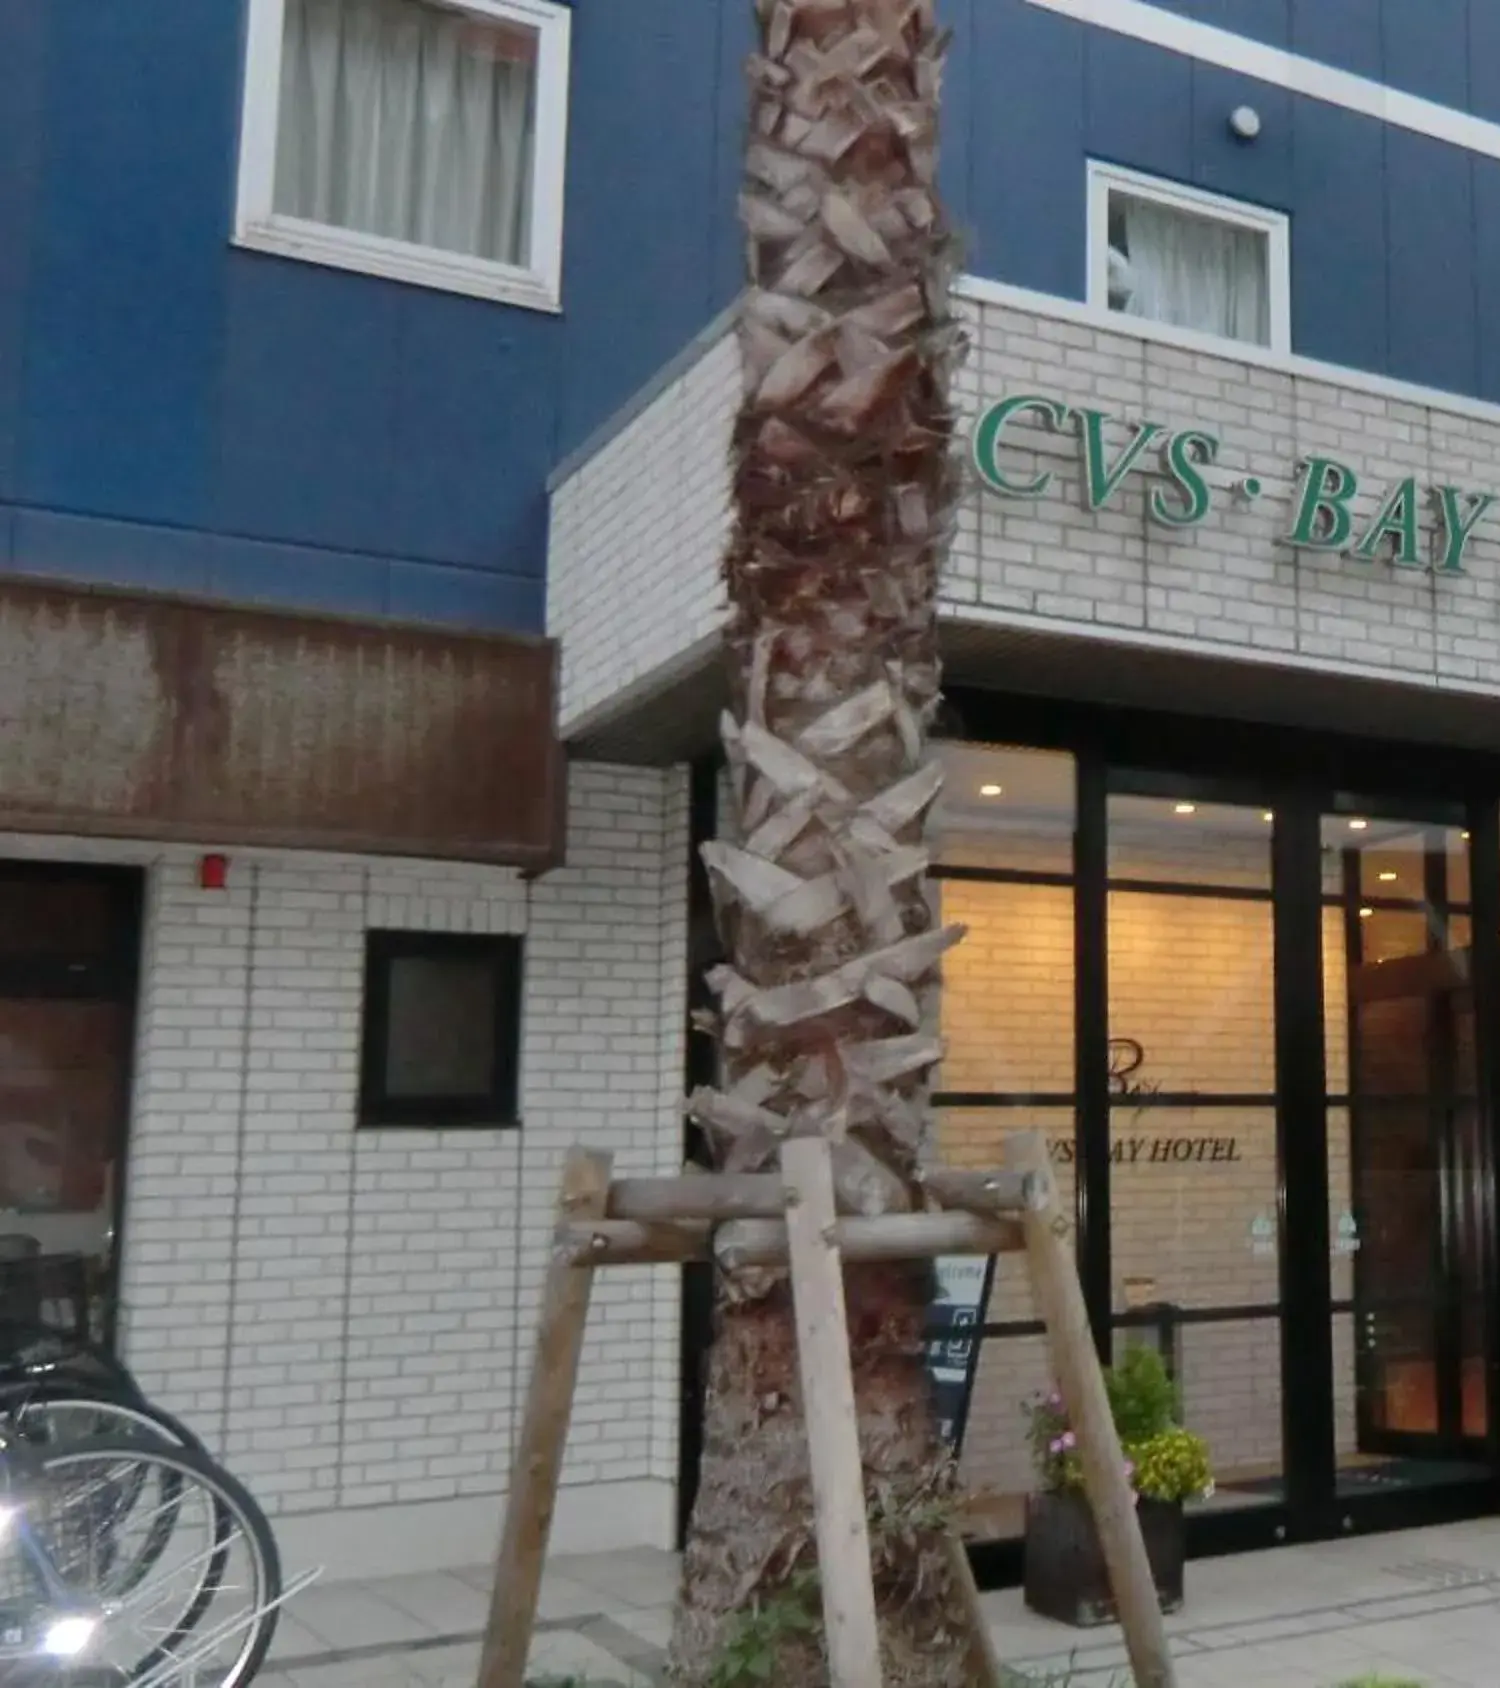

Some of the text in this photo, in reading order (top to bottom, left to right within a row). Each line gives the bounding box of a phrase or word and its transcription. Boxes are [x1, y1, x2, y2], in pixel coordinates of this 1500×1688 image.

[1282, 455, 1495, 577] BAY
[1108, 1137, 1145, 1163] AY
[1149, 1137, 1242, 1162] HOTEL
